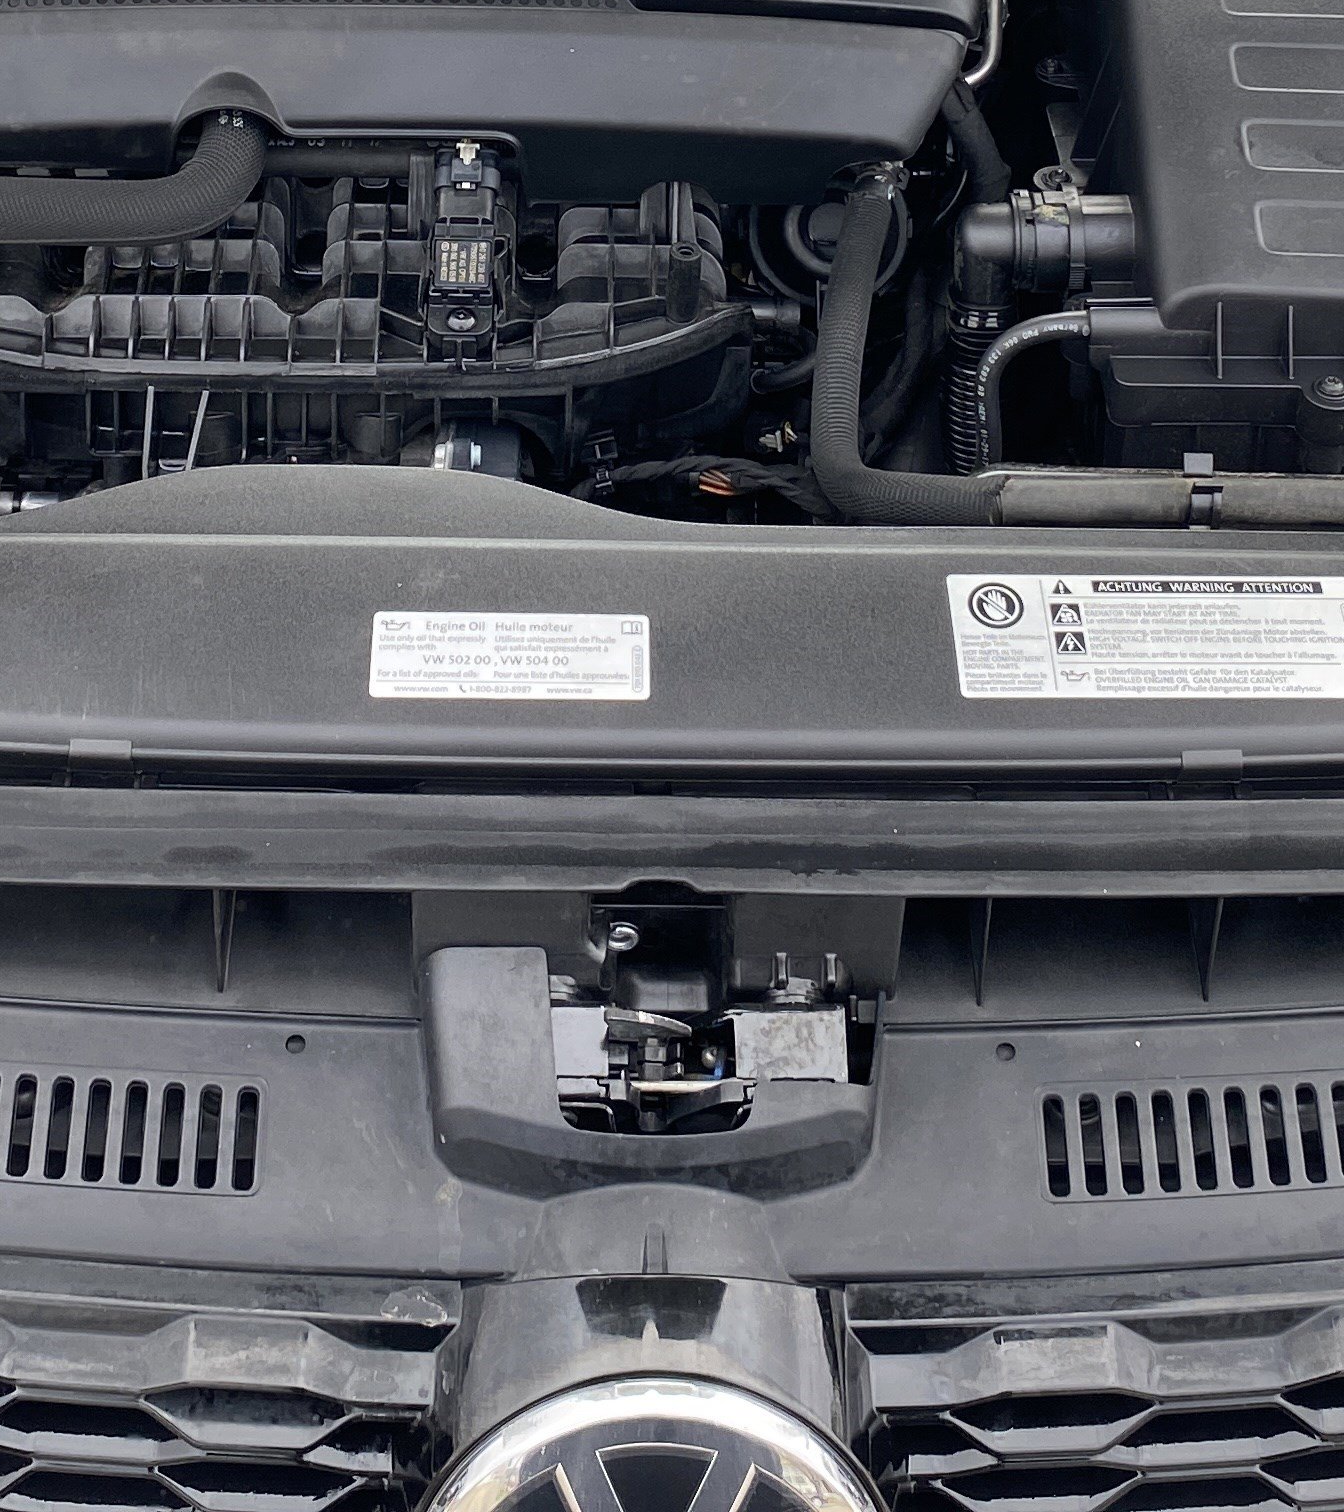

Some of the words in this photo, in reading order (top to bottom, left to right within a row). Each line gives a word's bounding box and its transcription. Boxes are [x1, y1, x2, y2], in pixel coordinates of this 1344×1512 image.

[1098, 582, 1162, 593] ACHTUNG
[1169, 582, 1234, 593] WARNING
[1242, 582, 1314, 593] ATTENTION
[425, 621, 460, 632] Engine
[466, 621, 486, 632] Oil
[495, 621, 526, 632] Huile
[529, 623, 573, 632] moteur
[396, 635, 414, 644] only
[429, 635, 446, 643] that
[448, 636, 486, 644] expressly
[527, 637, 577, 645] uniquement
[579, 636, 590, 644] de
[378, 643, 415, 652] complies
[417, 642, 436, 651] with
[494, 645, 507, 653] qui
[509, 644, 542, 652] satisfait
[423, 655, 446, 665] VW
[449, 655, 471, 665] 502
[501, 656, 523, 665] VW
[525, 656, 549, 665] 504
[552, 656, 569, 665] 00
[377, 669, 390, 678] For
[399, 669, 411, 678] list
[413, 669, 422, 678] of
[423, 670, 461, 679] approved
[494, 671, 511, 679] Pour
[531, 670, 548, 679] liste
[393, 685, 448, 693] www.vw.com
[546, 686, 593, 694] www.vw.ca
